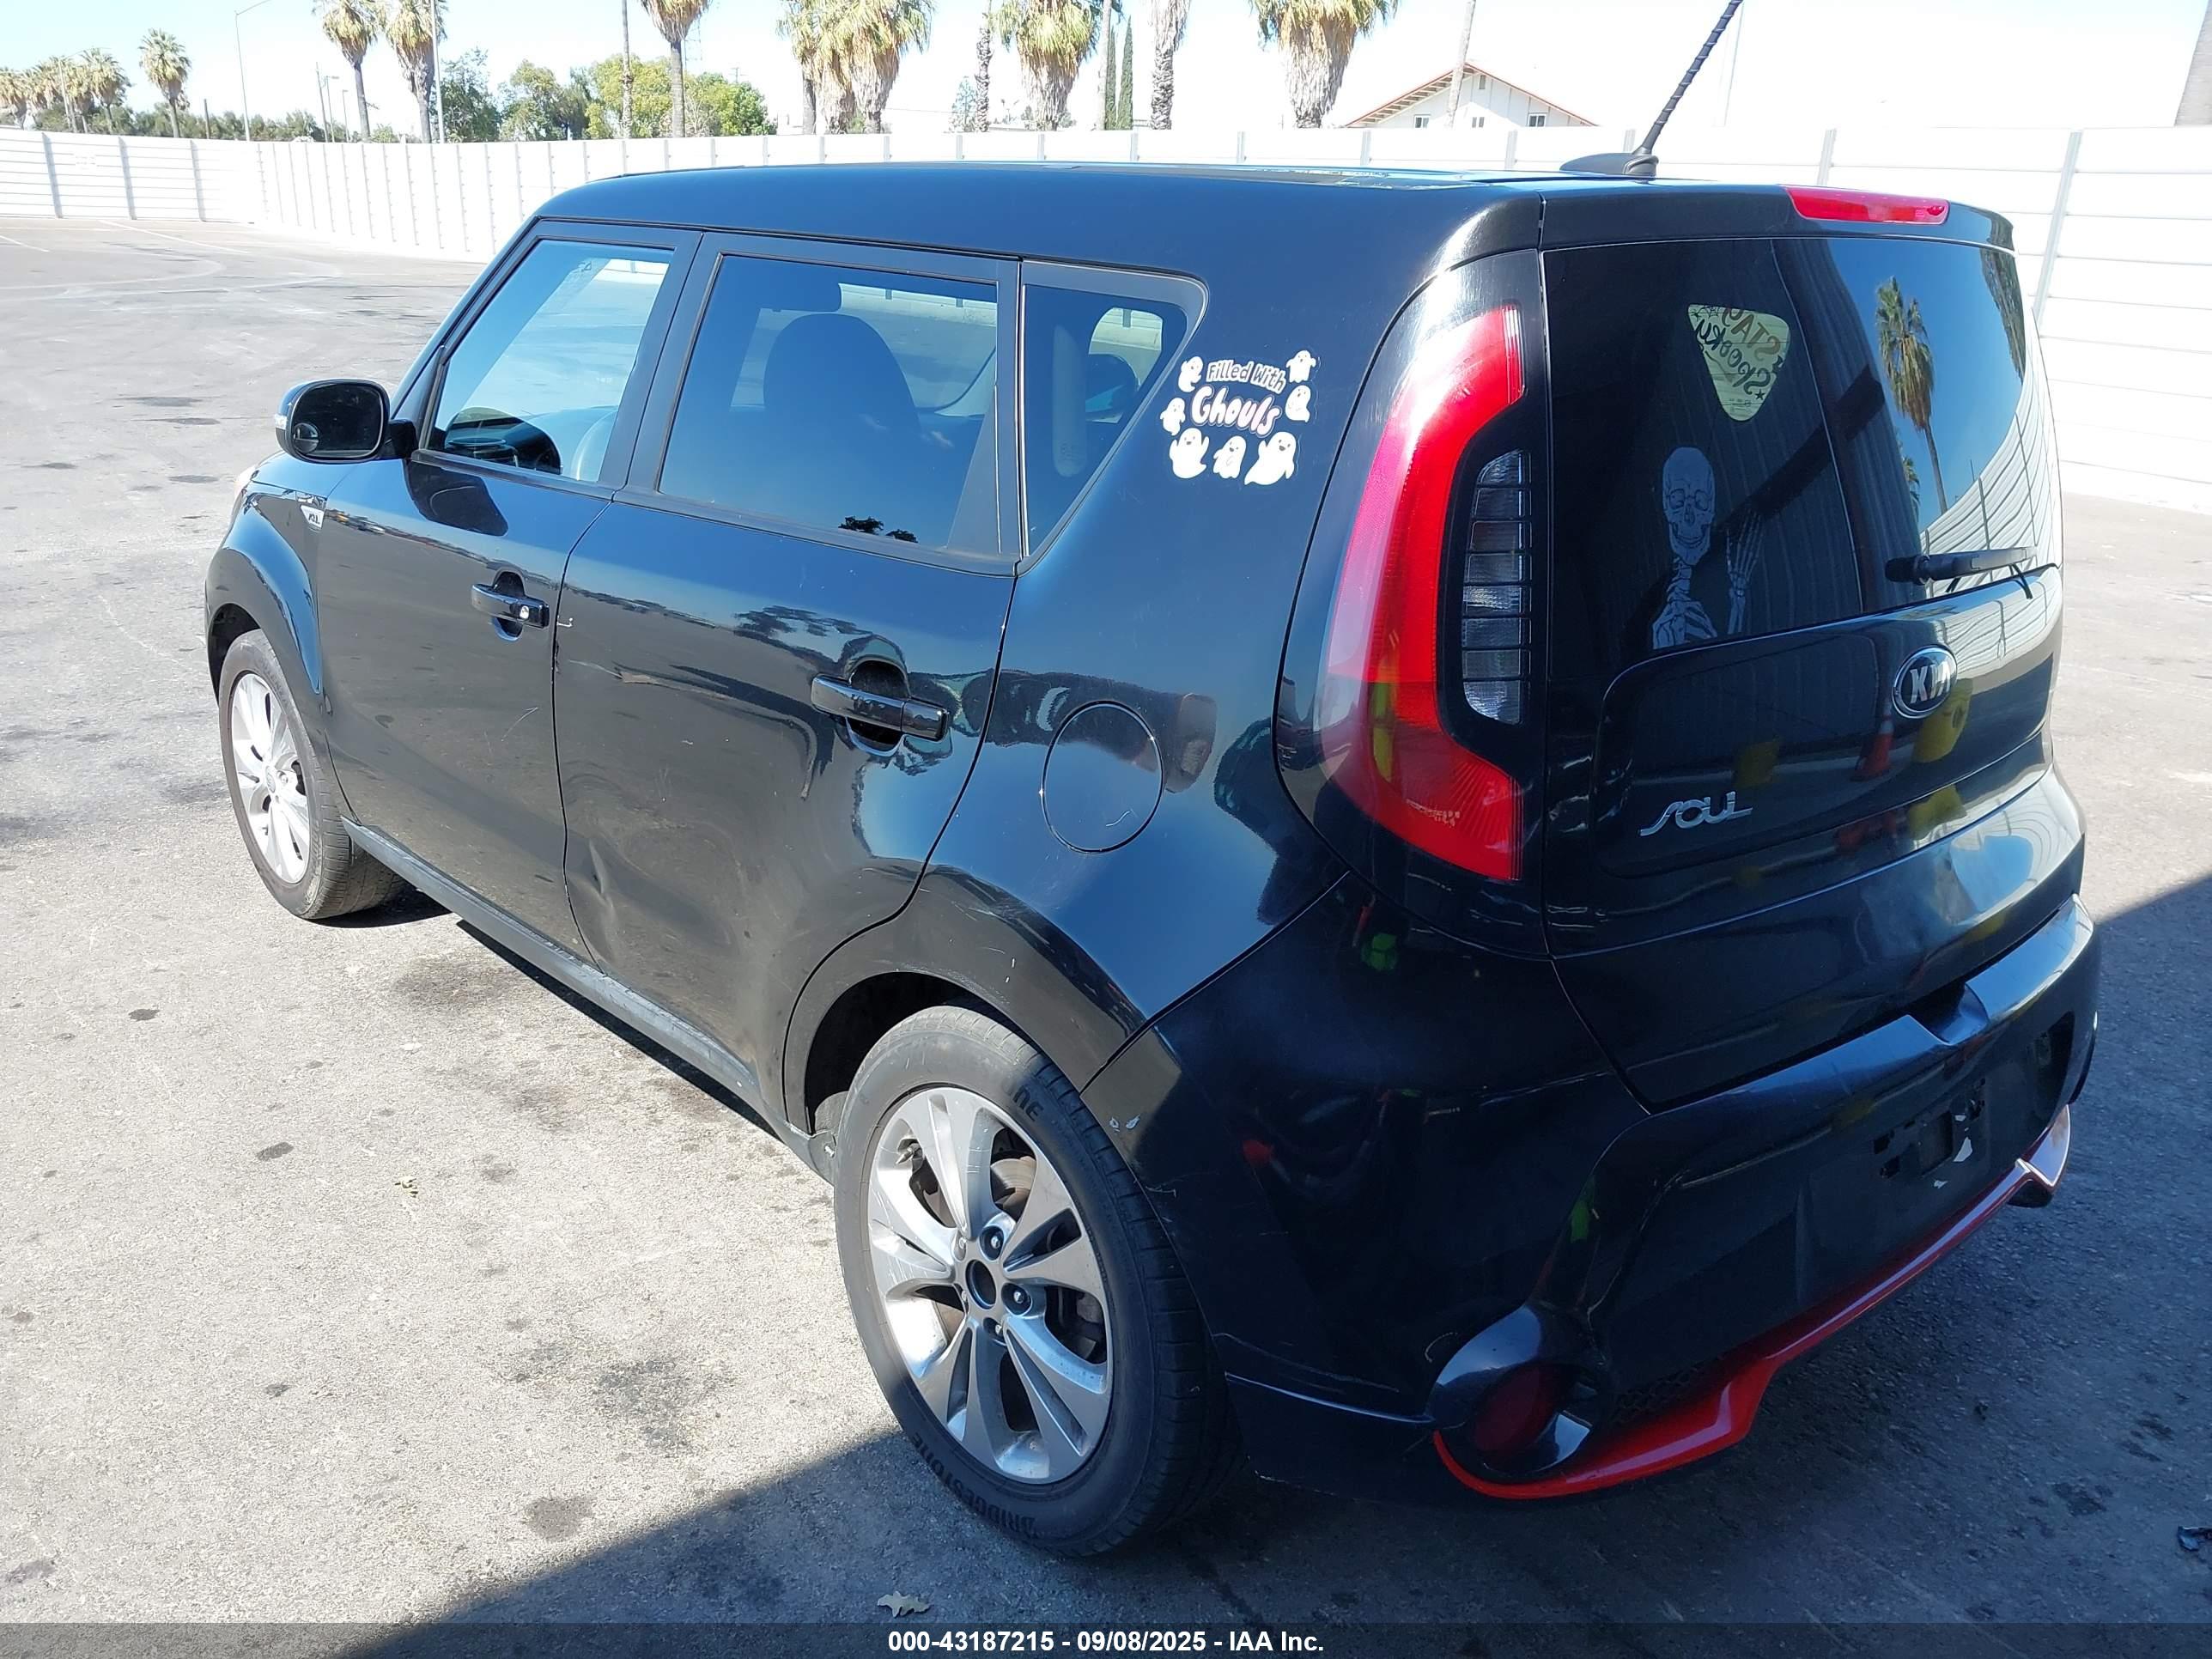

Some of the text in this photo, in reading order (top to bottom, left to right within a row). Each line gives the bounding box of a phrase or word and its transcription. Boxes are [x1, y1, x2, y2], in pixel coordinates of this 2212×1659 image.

[1207, 362, 1285, 392] Filled With
[1191, 385, 1282, 438] Ghouls
[1910, 662, 1952, 704] KIA
